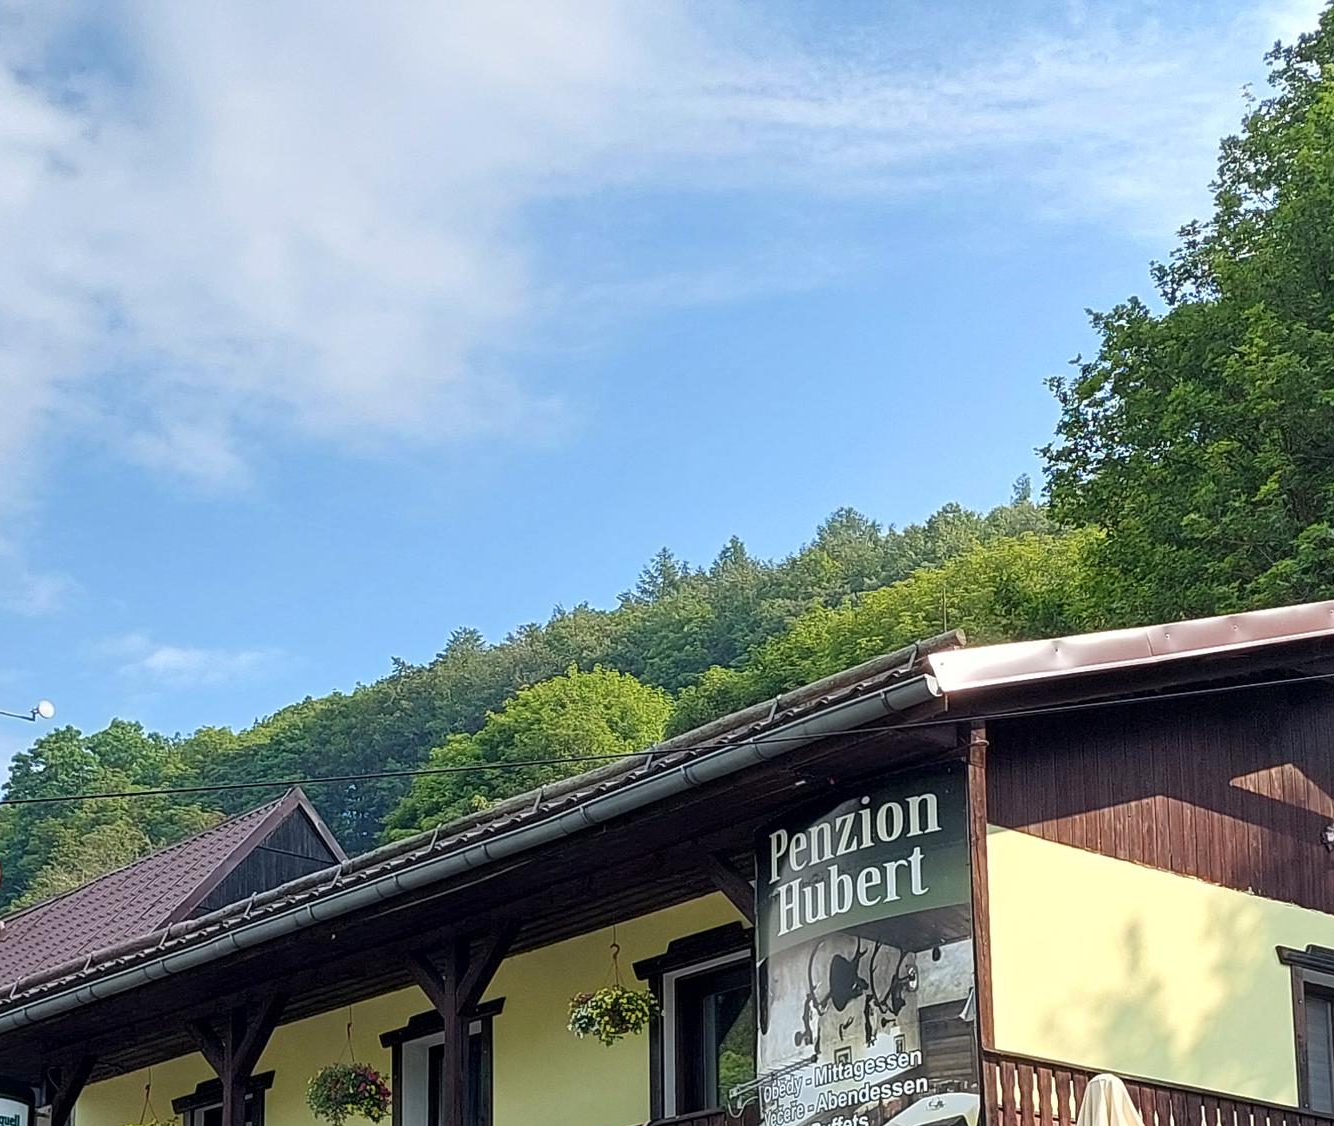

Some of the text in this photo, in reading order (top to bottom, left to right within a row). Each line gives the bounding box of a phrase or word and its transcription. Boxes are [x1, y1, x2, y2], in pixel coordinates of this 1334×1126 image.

[768, 792, 942, 885] Penzion
[777, 846, 930, 936] Hubert
[814, 1048, 923, 1089] Mittagessen
[815, 1076, 929, 1114] Abendessen
